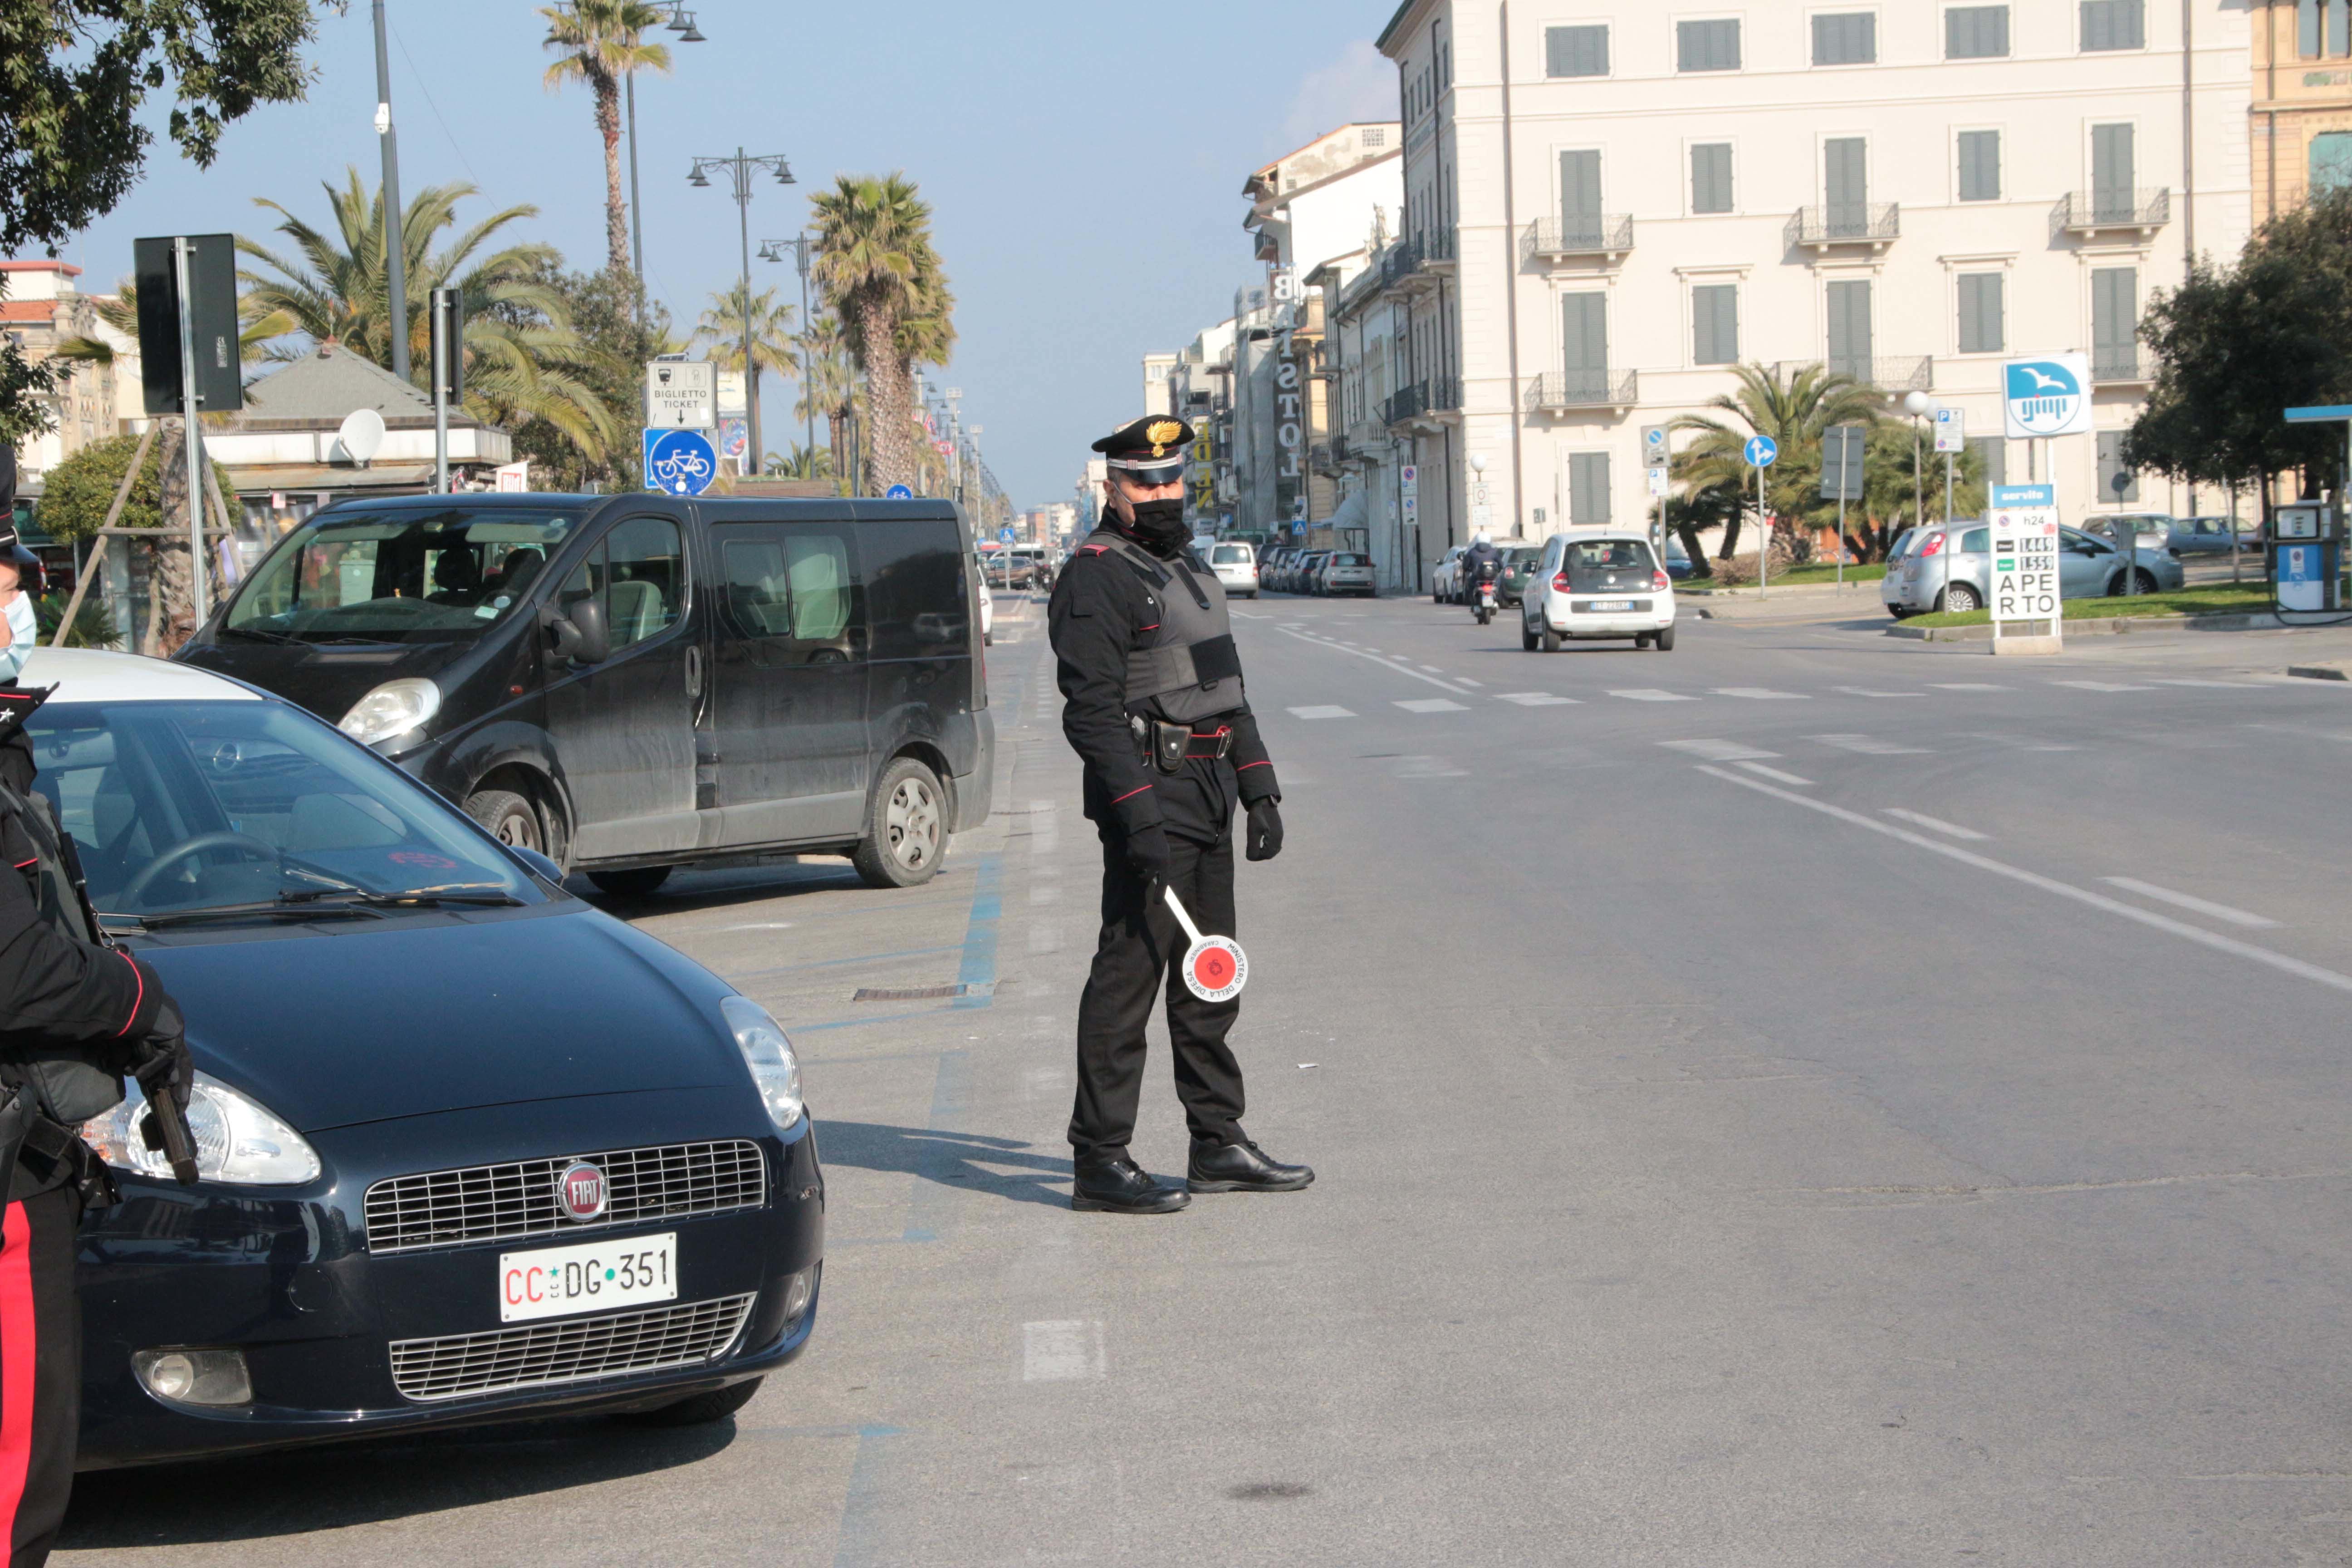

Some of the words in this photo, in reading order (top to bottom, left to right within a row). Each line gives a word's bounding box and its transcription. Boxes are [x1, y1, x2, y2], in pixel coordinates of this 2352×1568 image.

[2001, 490, 2043, 500] servito
[2024, 516, 2044, 525] h24
[1189, 941, 1219, 962] CARABINIERI
[1227, 943, 1244, 984] MINISTERO
[1187, 970, 1206, 995] DIFESA
[1210, 985, 1235, 997] DELLA
[571, 1179, 598, 1205] FIAT
